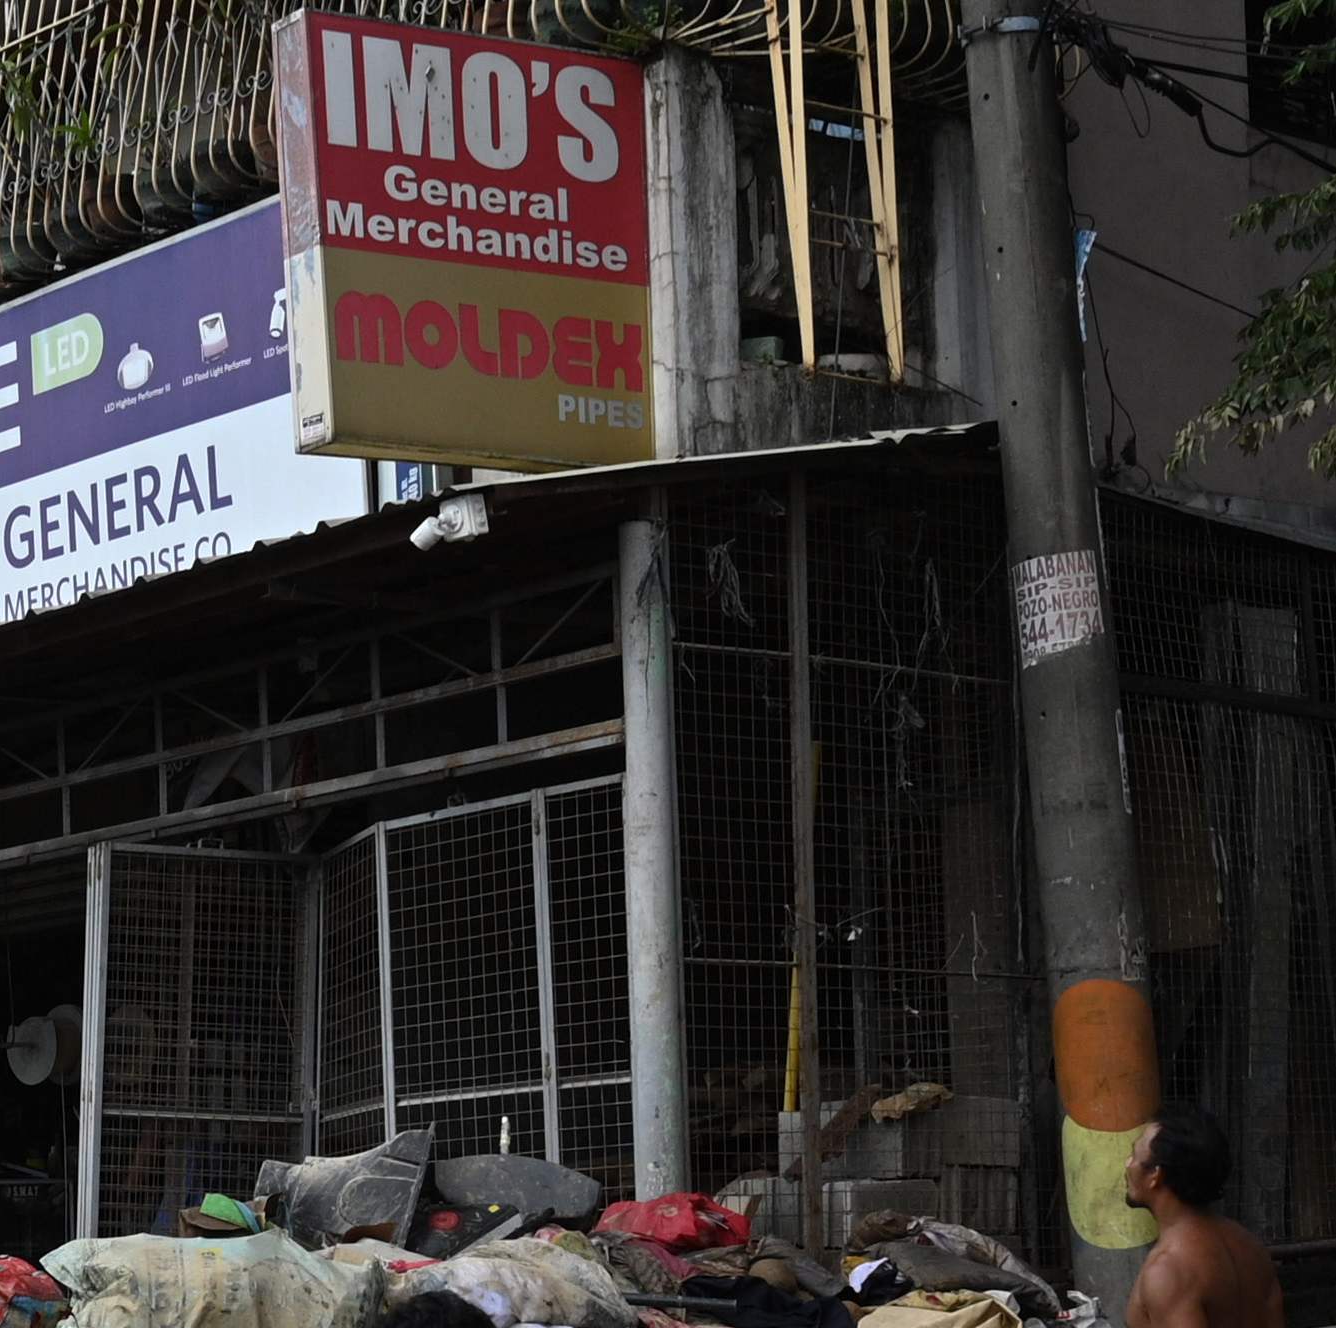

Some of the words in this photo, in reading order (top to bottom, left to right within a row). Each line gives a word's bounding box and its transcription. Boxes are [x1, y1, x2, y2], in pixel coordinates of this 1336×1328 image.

[322, 29, 620, 184] IMO'S
[383, 164, 569, 223] General
[327, 200, 629, 272] Merchandise
[44, 326, 91, 378] LED
[334, 290, 644, 393] MOLDEX
[558, 394, 644, 431] PIPES
[3, 444, 234, 571] GENERAL
[1015, 551, 1094, 588] MALABANAN
[1018, 577, 1095, 602] SIP-SIP
[1019, 590, 1098, 622] POZO-NEGRO
[1021, 611, 1102, 650] 544-1734
